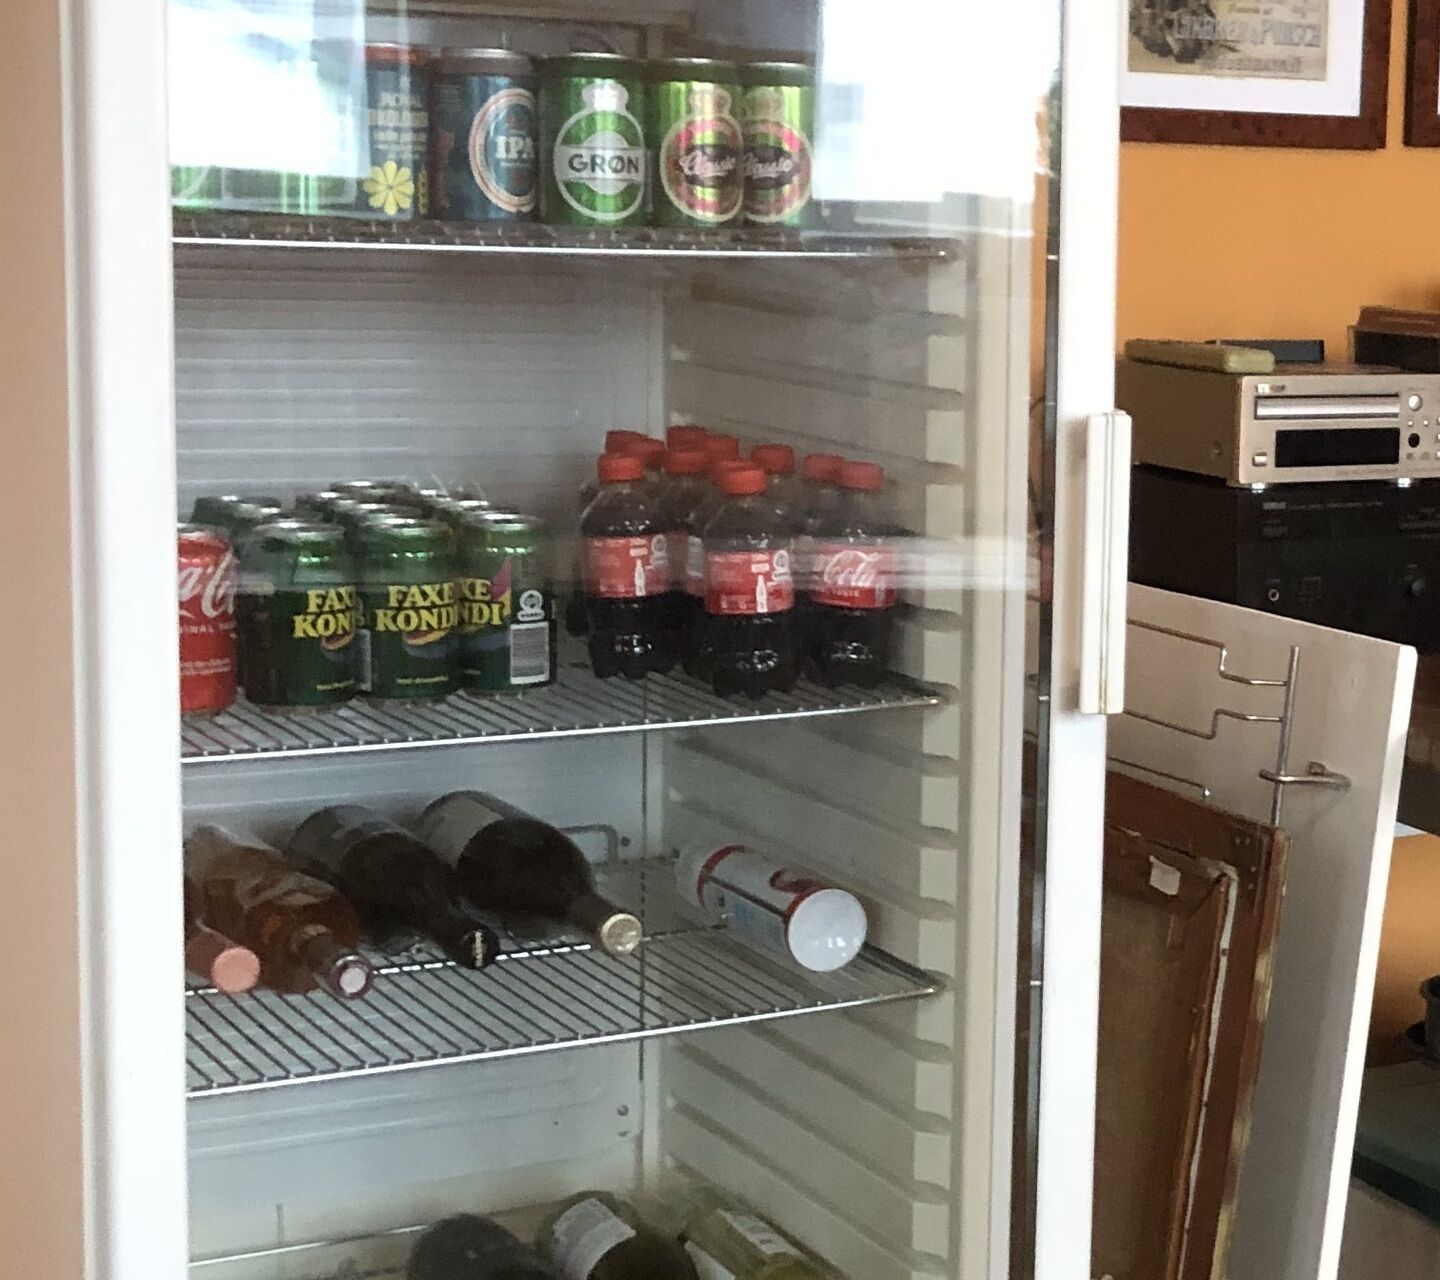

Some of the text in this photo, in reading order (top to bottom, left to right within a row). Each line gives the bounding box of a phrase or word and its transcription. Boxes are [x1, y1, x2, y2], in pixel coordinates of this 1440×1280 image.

[568, 153, 639, 174] GRØN
[306, 586, 356, 613] FAX
[292, 612, 355, 639] KON
